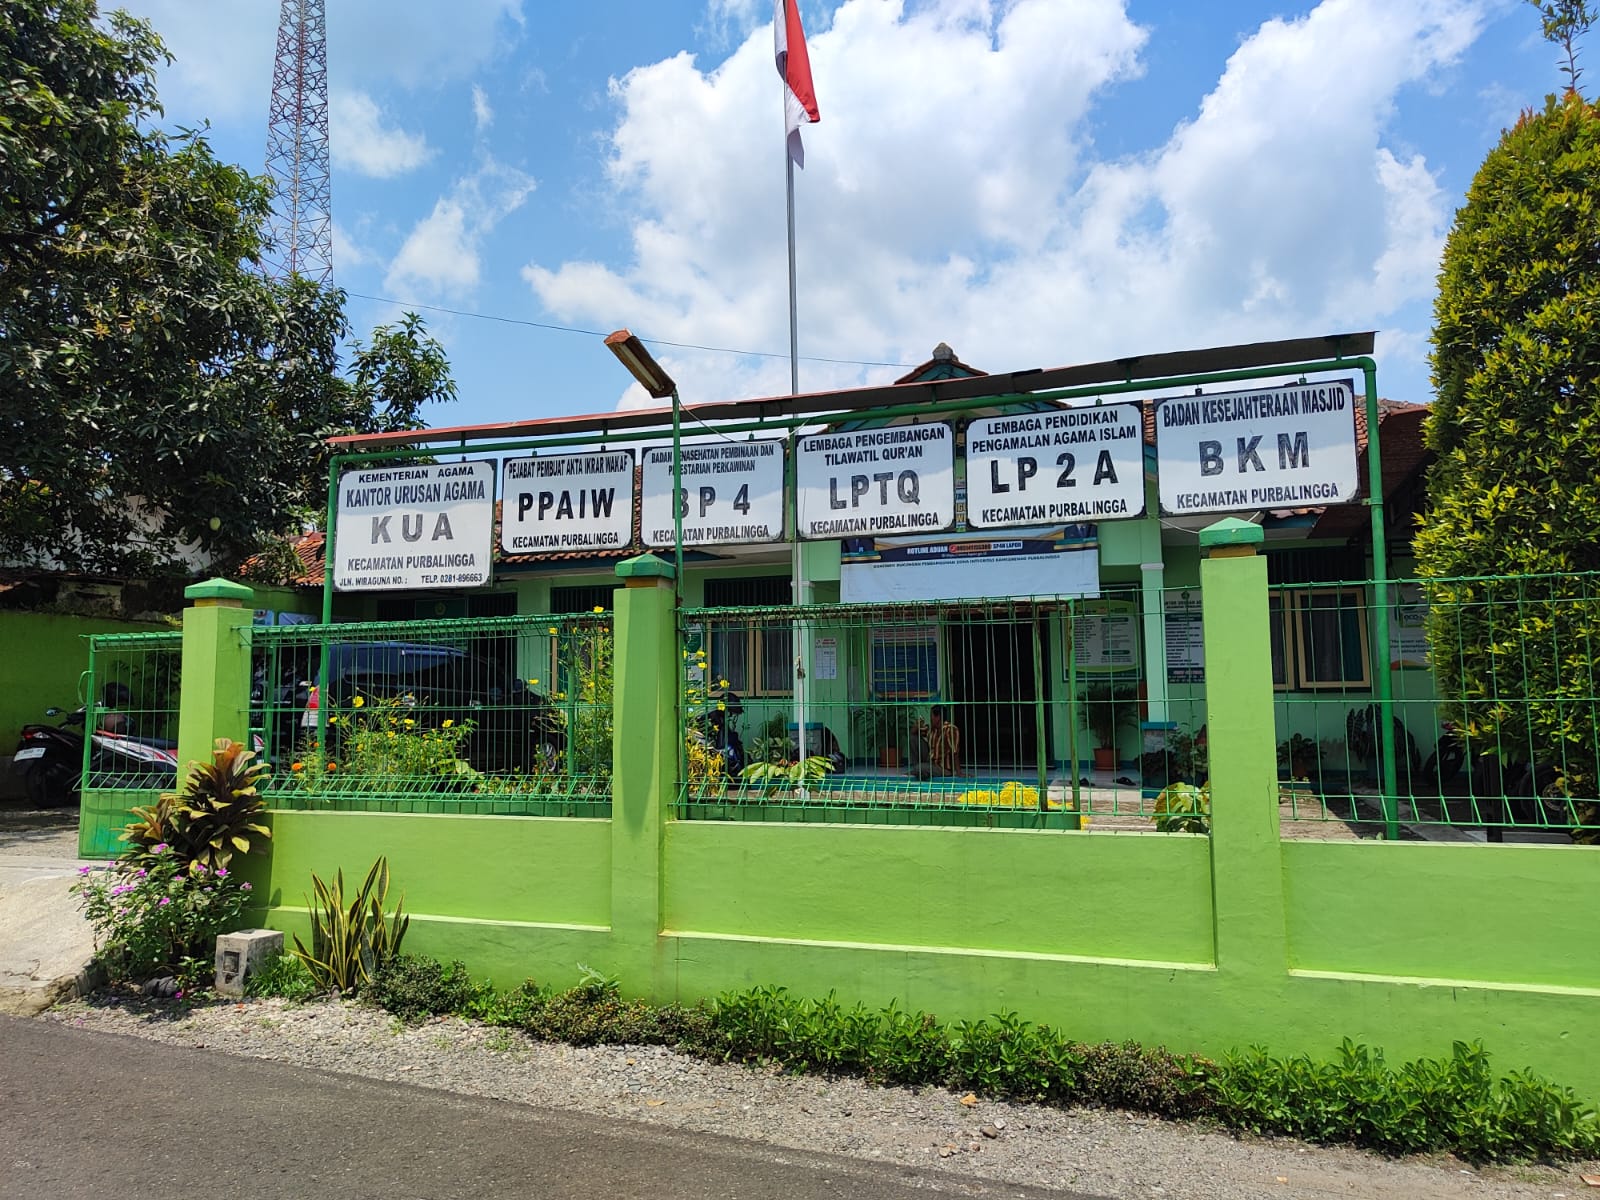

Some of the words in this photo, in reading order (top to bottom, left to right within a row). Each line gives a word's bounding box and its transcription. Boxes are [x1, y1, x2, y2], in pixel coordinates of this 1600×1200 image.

[1163, 403, 1200, 427] BADAN
[1203, 392, 1299, 424] KESEJAHTERAAN
[1301, 387, 1345, 414] MASJID
[987, 418, 1043, 435] LEMBAGA
[1045, 410, 1118, 430] PENDIDIKAN
[803, 432, 851, 452] LEMBAGA
[853, 427, 945, 448] PENGEMBANGAN
[972, 434, 1050, 453] PENGAMALAN
[1053, 430, 1097, 446] AGAMA
[1099, 425, 1137, 441] ISLAM
[651, 452, 672, 463] BADAN
[679, 448, 719, 461] ENASEHATAN
[720, 446, 758, 459] PEMBINAAN
[760, 445, 774, 456] DAN
[824, 449, 880, 466] TILAWATIL
[881, 445, 923, 461] QUR'AN
[358, 469, 428, 483] KEMENTERIAN
[437, 466, 475, 477] AGAMA
[508, 460, 535, 480] PEJABAT
[536, 458, 565, 478] PEMBUAT
[566, 457, 582, 475] AKTA
[583, 456, 604, 474] IKRAR
[605, 454, 628, 472] WAKAF
[712, 460, 756, 473] PERKAWINAN
[346, 486, 393, 508] KANTOR
[394, 483, 441, 505] URUSAN
[443, 480, 486, 502] AGAMA
[829, 469, 920, 511] LPTQ
[1177, 490, 1248, 509] KECAMATAN
[1250, 483, 1338, 504] PURBALINGGA
[518, 487, 615, 522] PPAIW
[982, 505, 1046, 523] KECAMATAN
[1048, 499, 1128, 518] PURBALINGGA
[653, 528, 704, 542] KECAATAN
[706, 525, 769, 540] PURBALINGGA
[810, 517, 868, 535] KECAMATAN
[869, 512, 939, 530] PURBALINGGA
[512, 536, 559, 548] KECAMATAN
[561, 532, 618, 546] PURBALINGGA
[348, 557, 404, 571] KECAMATAN
[406, 553, 475, 569] PURBALINGGA
[355, 576, 390, 586] WIRAGUNA
[421, 575, 438, 584] TELP.
